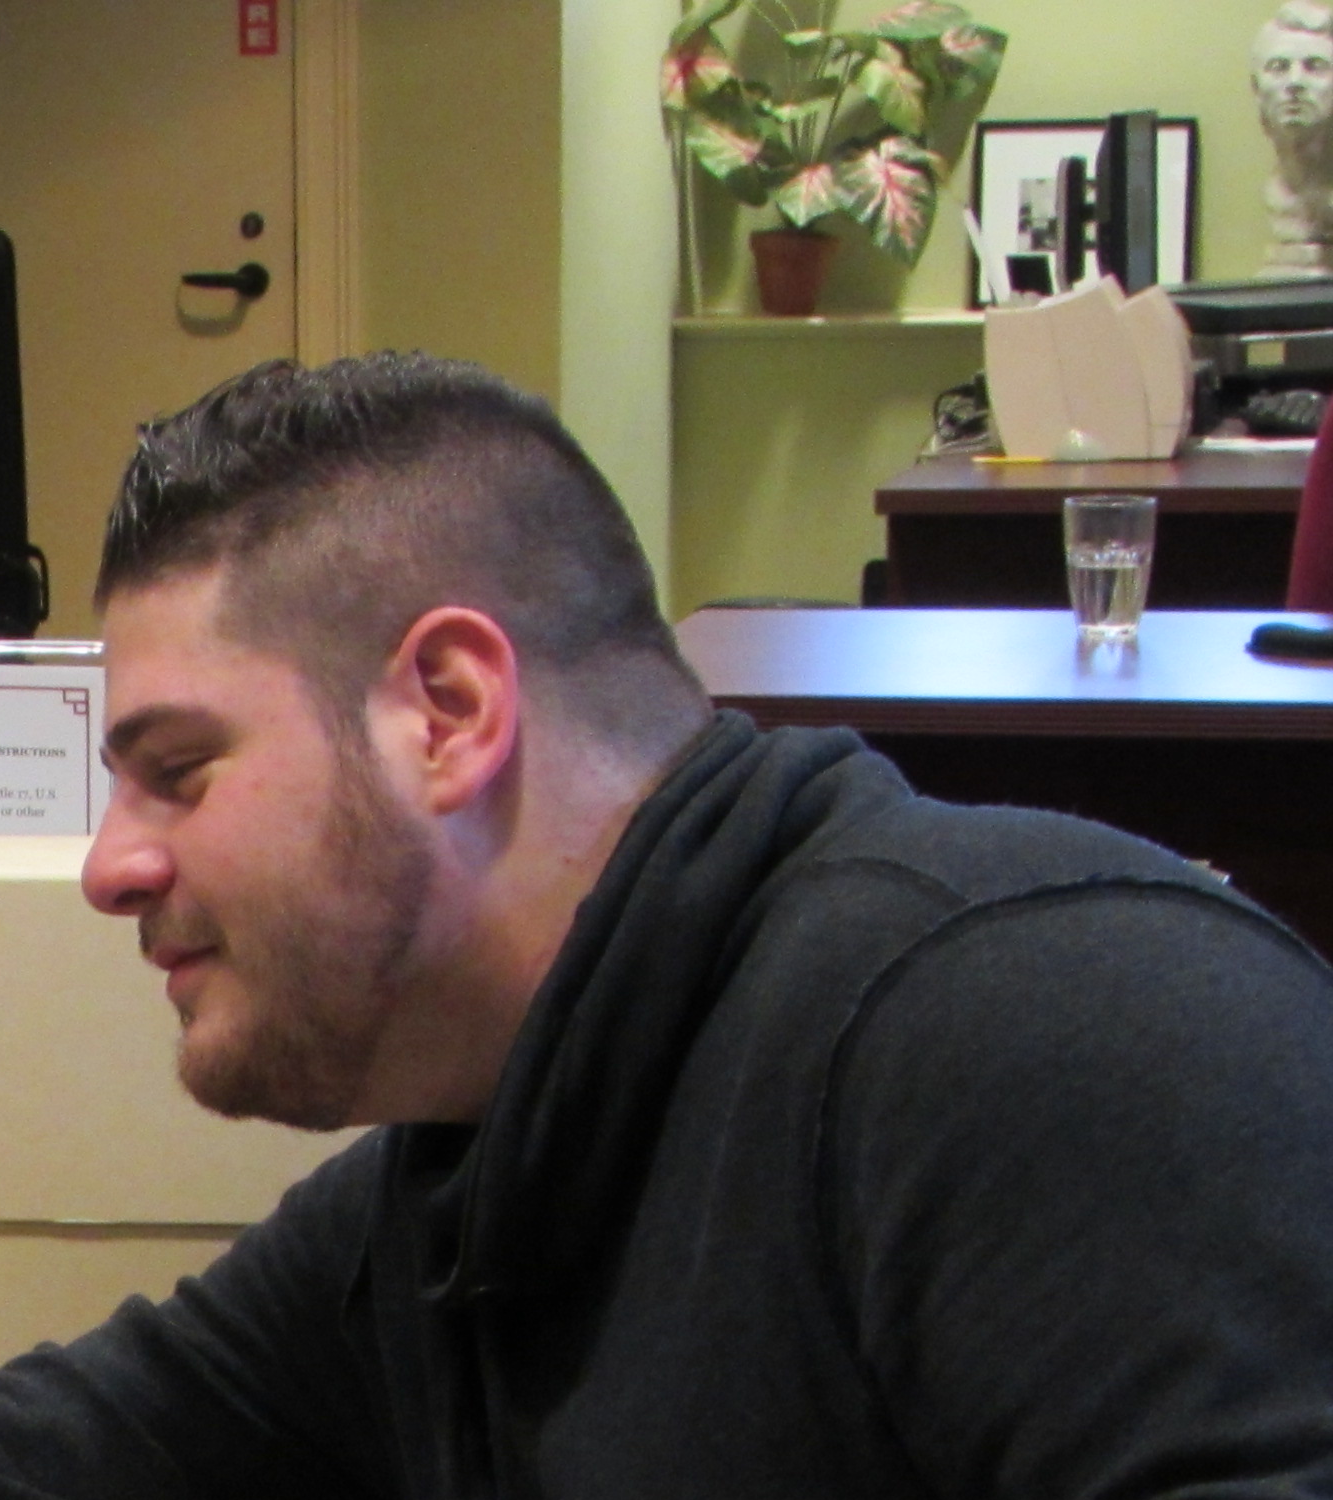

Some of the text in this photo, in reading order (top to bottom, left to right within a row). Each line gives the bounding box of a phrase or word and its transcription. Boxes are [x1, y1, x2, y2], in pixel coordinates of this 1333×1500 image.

[17, 788, 32, 800] 17,
[1, 806, 13, 816] or
[16, 805, 46, 818] other
